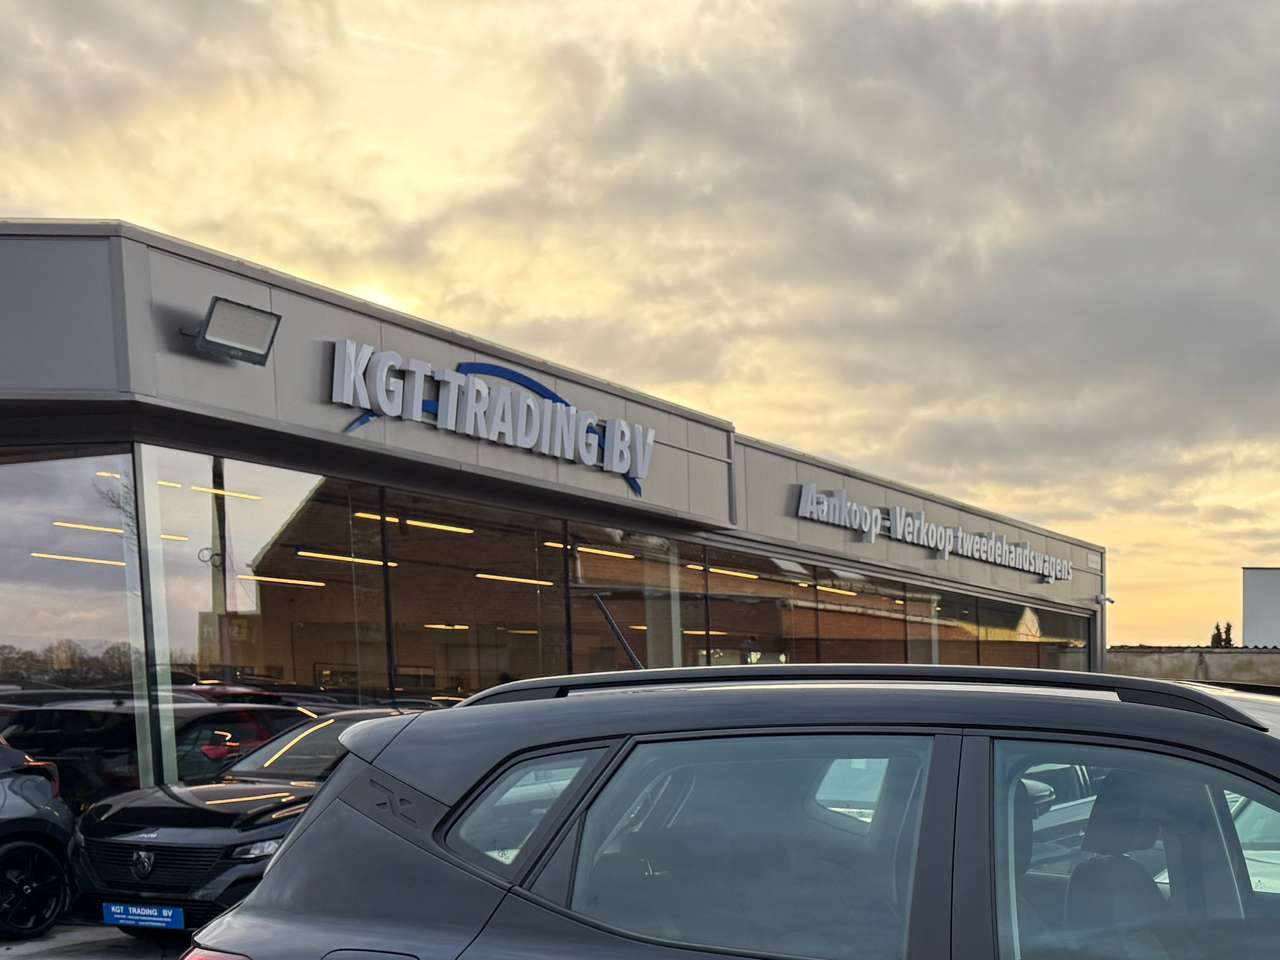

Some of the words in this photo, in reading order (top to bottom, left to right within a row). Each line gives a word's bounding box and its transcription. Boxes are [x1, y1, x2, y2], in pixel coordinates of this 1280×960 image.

[333, 338, 431, 422] KGT
[434, 368, 599, 466] TRADING
[604, 418, 655, 479] BV
[799, 483, 883, 544] Aankoop
[891, 505, 954, 561] Verkoop
[957, 526, 1073, 584] tweedehandswagens
[111, 905, 124, 913] KGT
[128, 906, 158, 916] TRADING
[162, 909, 173, 917] BV
